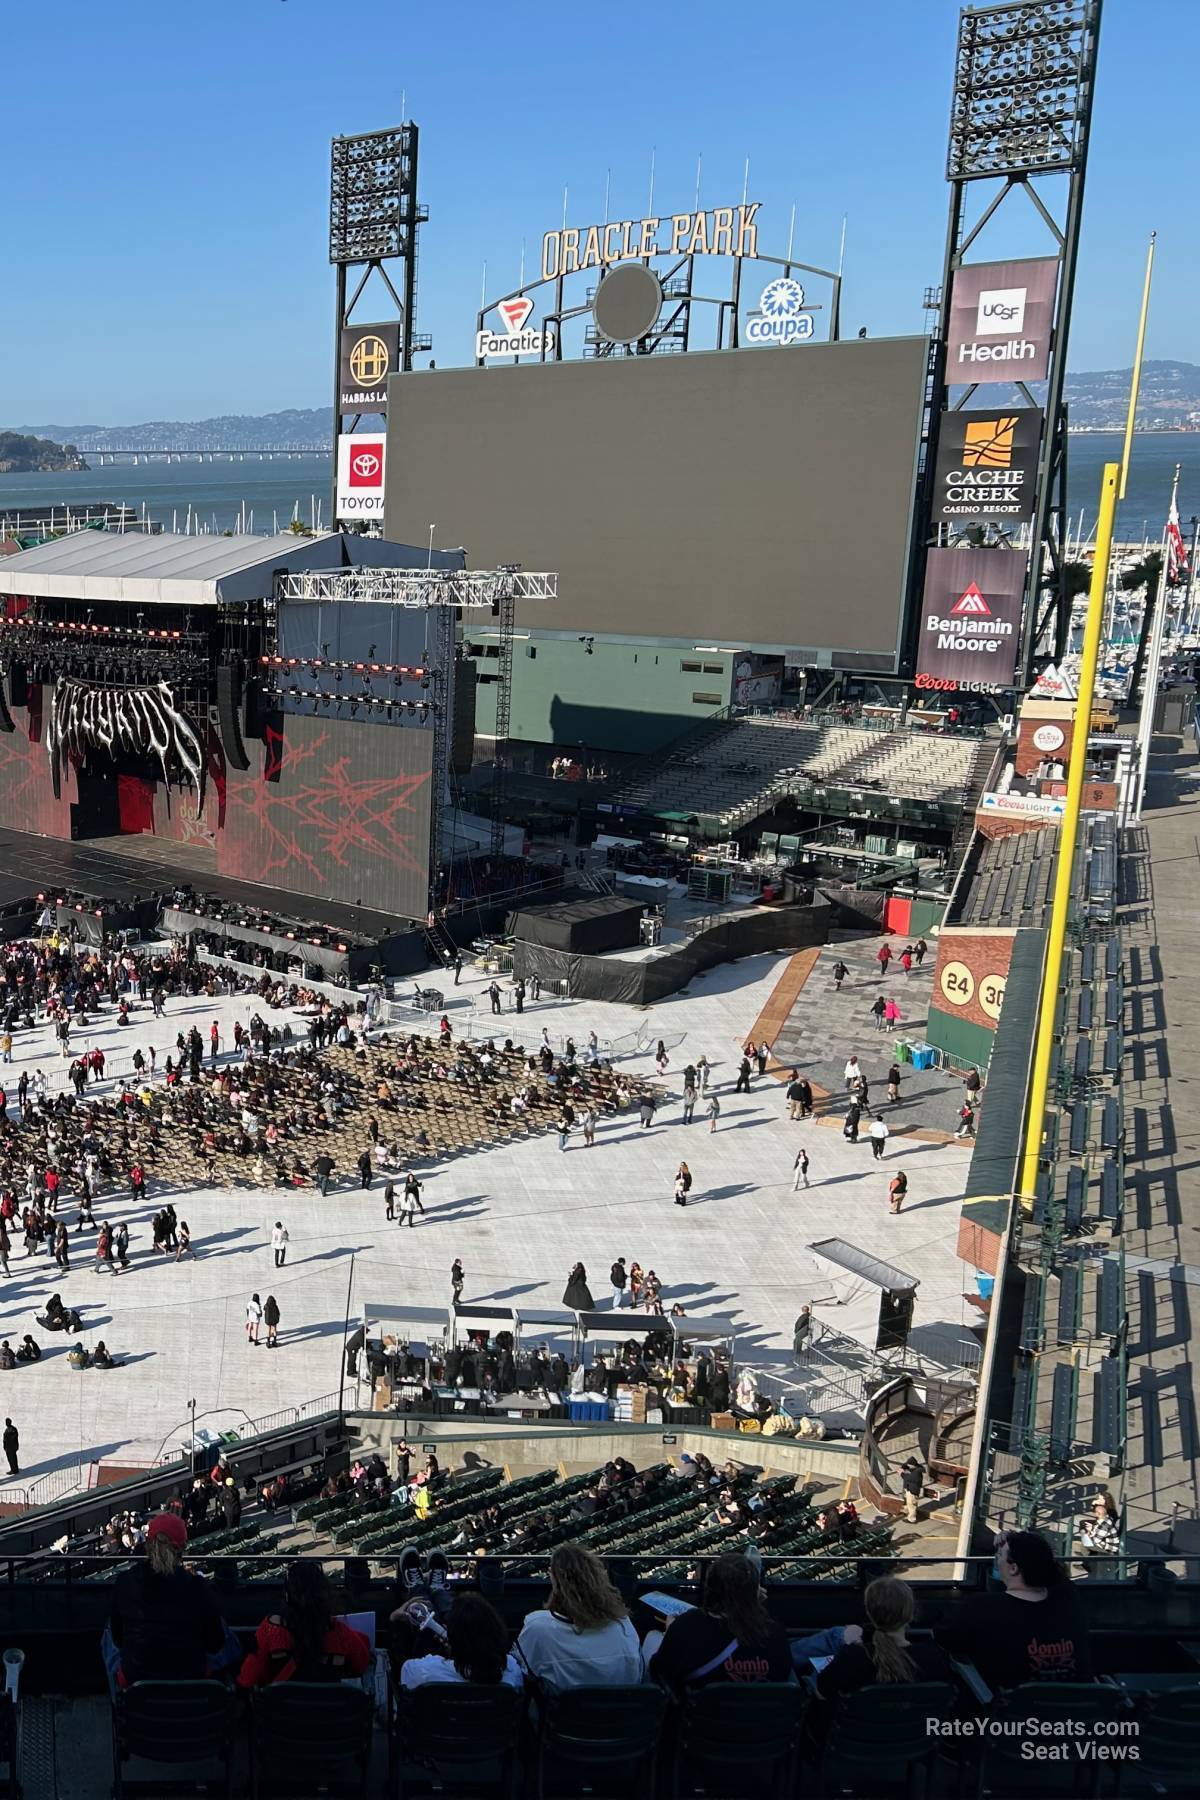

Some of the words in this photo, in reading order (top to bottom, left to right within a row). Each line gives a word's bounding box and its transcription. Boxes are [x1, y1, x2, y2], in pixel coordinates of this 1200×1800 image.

[542, 218, 659, 281] ORACLE
[670, 203, 761, 258] PARK
[983, 304, 1019, 320] UCSF
[749, 317, 810, 341] coupa
[479, 332, 551, 353] Fanatics
[958, 340, 1036, 362] Health
[342, 392, 376, 404] HABBAS
[376, 391, 388, 402] LA
[946, 470, 1024, 485] CACHE
[946, 487, 1020, 502] CREEK
[942, 505, 980, 513] CASINO
[982, 505, 1021, 513] RESORT
[927, 616, 1013, 636] Benjamin
[938, 634, 998, 652] Moore
[915, 673, 957, 691] Coors
[959, 681, 1000, 694] LIGHT
[998, 798, 1025, 810] Coors
[1026, 804, 1051, 813] LIGHT
[947, 973, 969, 995] 24
